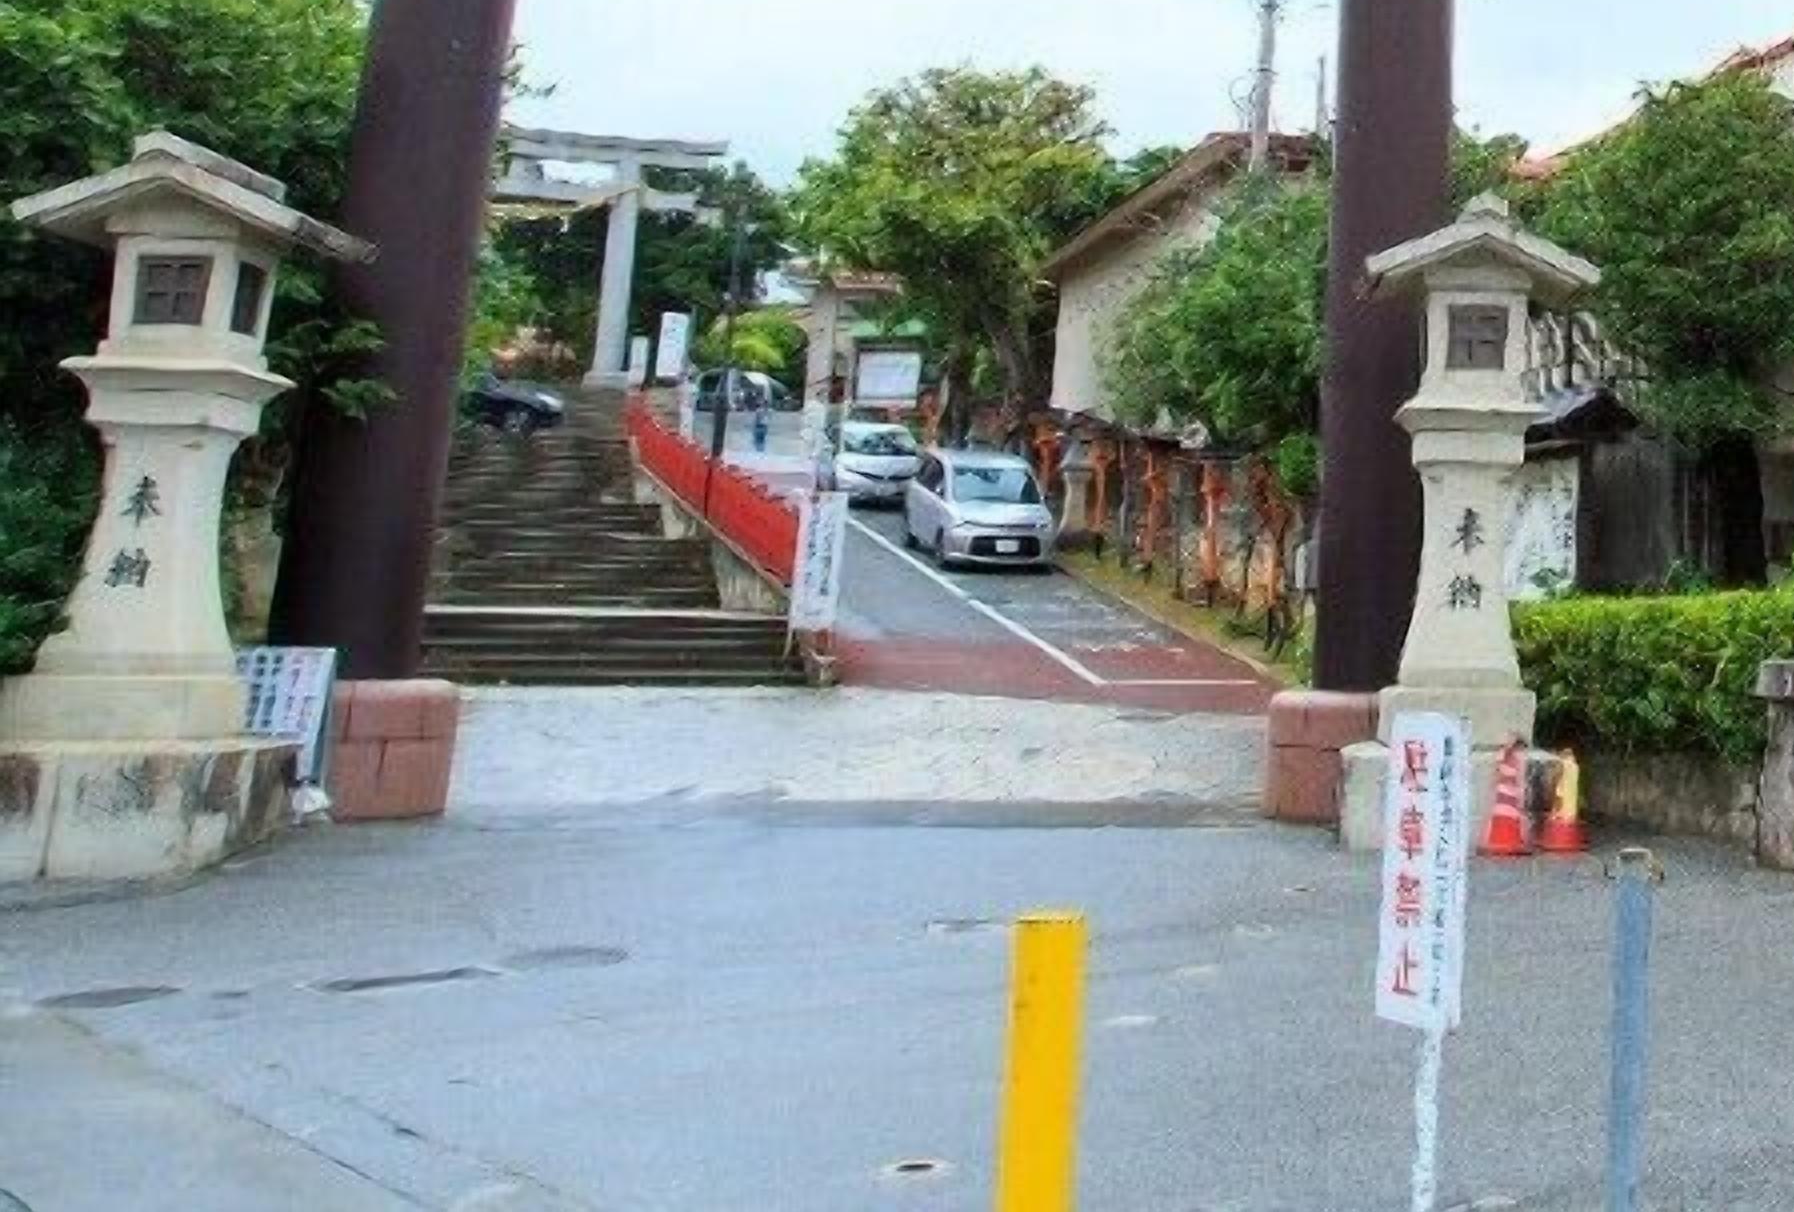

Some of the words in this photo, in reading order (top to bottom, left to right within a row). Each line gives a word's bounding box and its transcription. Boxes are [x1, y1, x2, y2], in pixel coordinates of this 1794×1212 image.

[103, 474, 162, 588] 奉納
[1447, 507, 1485, 610] 奉納
[1391, 739, 1428, 996] 駐車禁止
